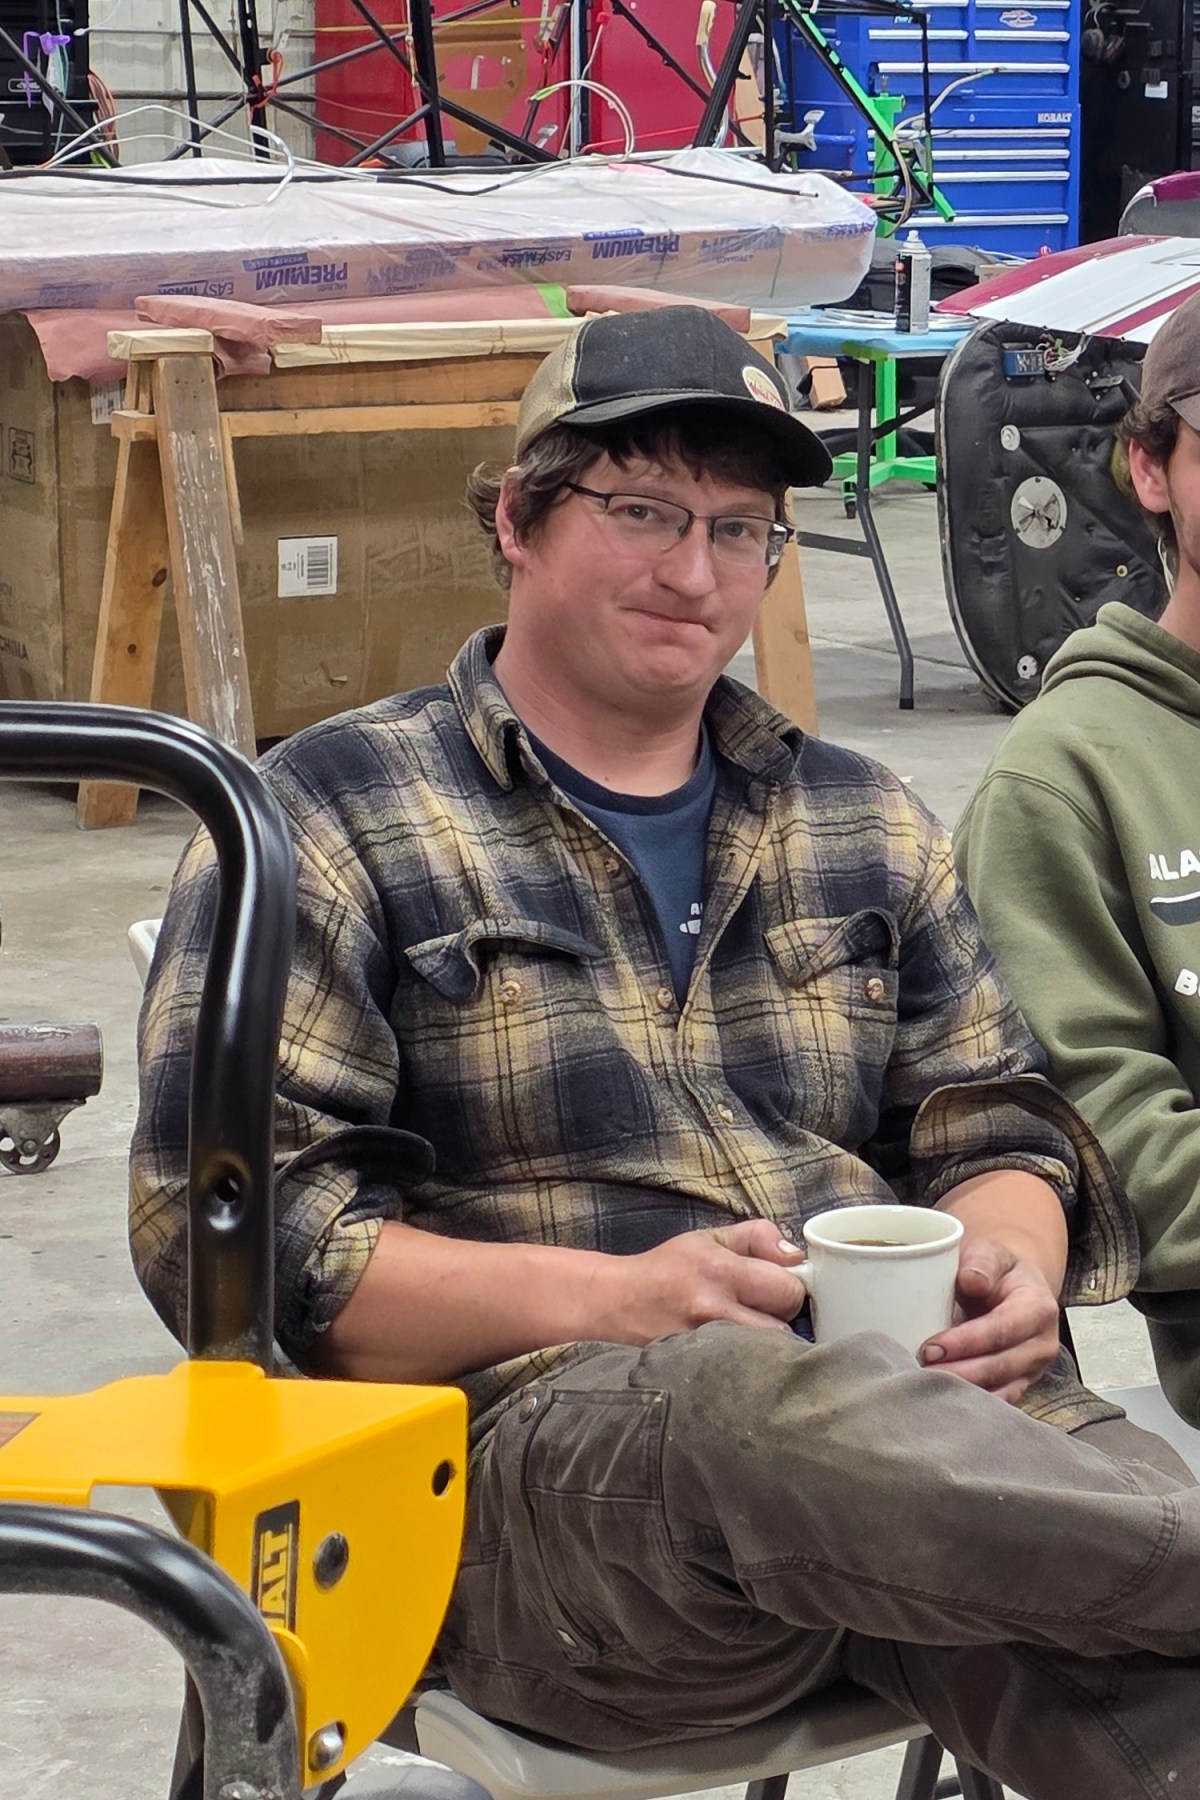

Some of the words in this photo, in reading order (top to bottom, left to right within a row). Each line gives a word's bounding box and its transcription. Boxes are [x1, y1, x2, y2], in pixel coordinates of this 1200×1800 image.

[1038, 113, 1072, 123] KOBALT
[540, 247, 571, 263] EASY
[592, 234, 679, 260] PREMIUM
[256, 262, 348, 291] PREMIUM
[203, 280, 234, 297] EASY
